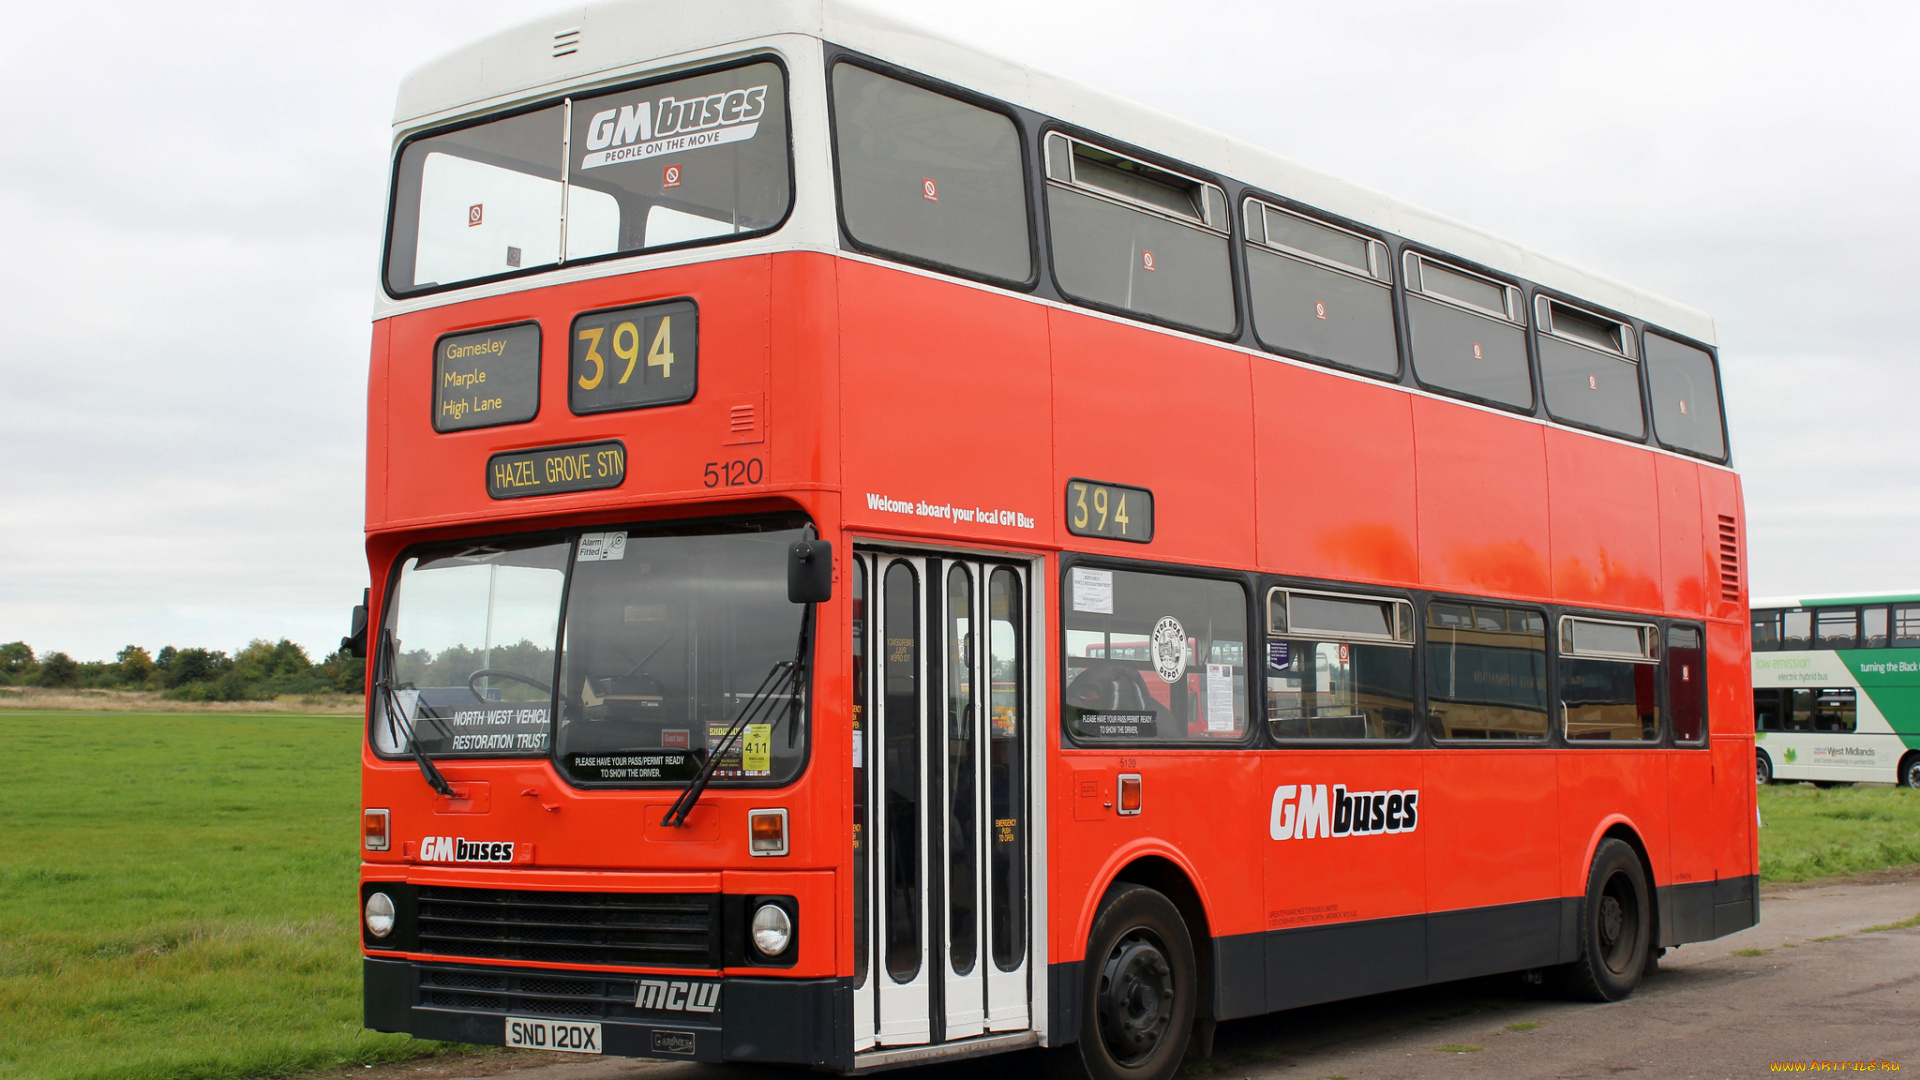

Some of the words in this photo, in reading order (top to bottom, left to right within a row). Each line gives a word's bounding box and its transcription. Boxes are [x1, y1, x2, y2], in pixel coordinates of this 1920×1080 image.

[605, 147, 642, 162] PEOPLE
[645, 143, 662, 154] ON
[666, 138, 684, 150] THE
[688, 131, 720, 146] MOVE
[446, 338, 507, 359] Gamesley
[578, 315, 674, 390] 394
[444, 369, 486, 388] Marple
[442, 399, 469, 420] High
[473, 395, 502, 412] Lane
[495, 460, 540, 489] HAZEL
[545, 453, 590, 483] GROVE
[597, 449, 624, 477] STN
[703, 458, 763, 488] 5120
[866, 492, 914, 515] Welcome
[915, 500, 951, 519] aboard
[952, 506, 975, 524] your
[975, 507, 998, 524] local
[999, 510, 1015, 527] GM
[1017, 512, 1035, 529] Bus
[1072, 483, 1130, 535] 394
[581, 539, 602, 547] Alarm
[580, 548, 600, 556] Fitted
[1154, 620, 1167, 642] HYDE
[1168, 620, 1184, 642] ROAD
[1755, 657, 1770, 669] low
[1772, 656, 1811, 669] emission
[1860, 661, 1886, 674] turning
[1886, 661, 1899, 672] the
[1899, 661, 1918, 672] Black
[1159, 666, 1179, 679] DEPOT
[1778, 672, 1798, 681] electric
[1799, 672, 1817, 683] hybrid
[1818, 672, 1829, 681] bus
[453, 711, 485, 726] NORTH
[487, 710, 513, 725] WEST
[1082, 714, 1096, 723] PLEASE
[452, 734, 514, 750] RESTORATION
[517, 733, 547, 748] TRUST
[745, 742, 767, 754] 411
[1827, 746, 1844, 755] West
[1845, 746, 1876, 756] Midlands
[575, 757, 596, 766] PLEASE
[596, 757, 611, 766] HAVE
[612, 757, 627, 766] YOUR
[665, 755, 684, 765] READY
[1120, 758, 1136, 769] 5120
[601, 769, 609, 777] TO
[609, 769, 626, 777] SHOW
[628, 768, 638, 777] THE
[640, 768, 661, 777] DRIVER.
[995, 819, 1016, 827] EMERGENCY
[1001, 827, 1011, 835] PUSH
[998, 834, 1004, 842] TO
[1004, 834, 1014, 842] OPEN
[634, 979, 721, 1013] MCW
[511, 1020, 546, 1047] SND
[551, 1025, 596, 1050] 120X
